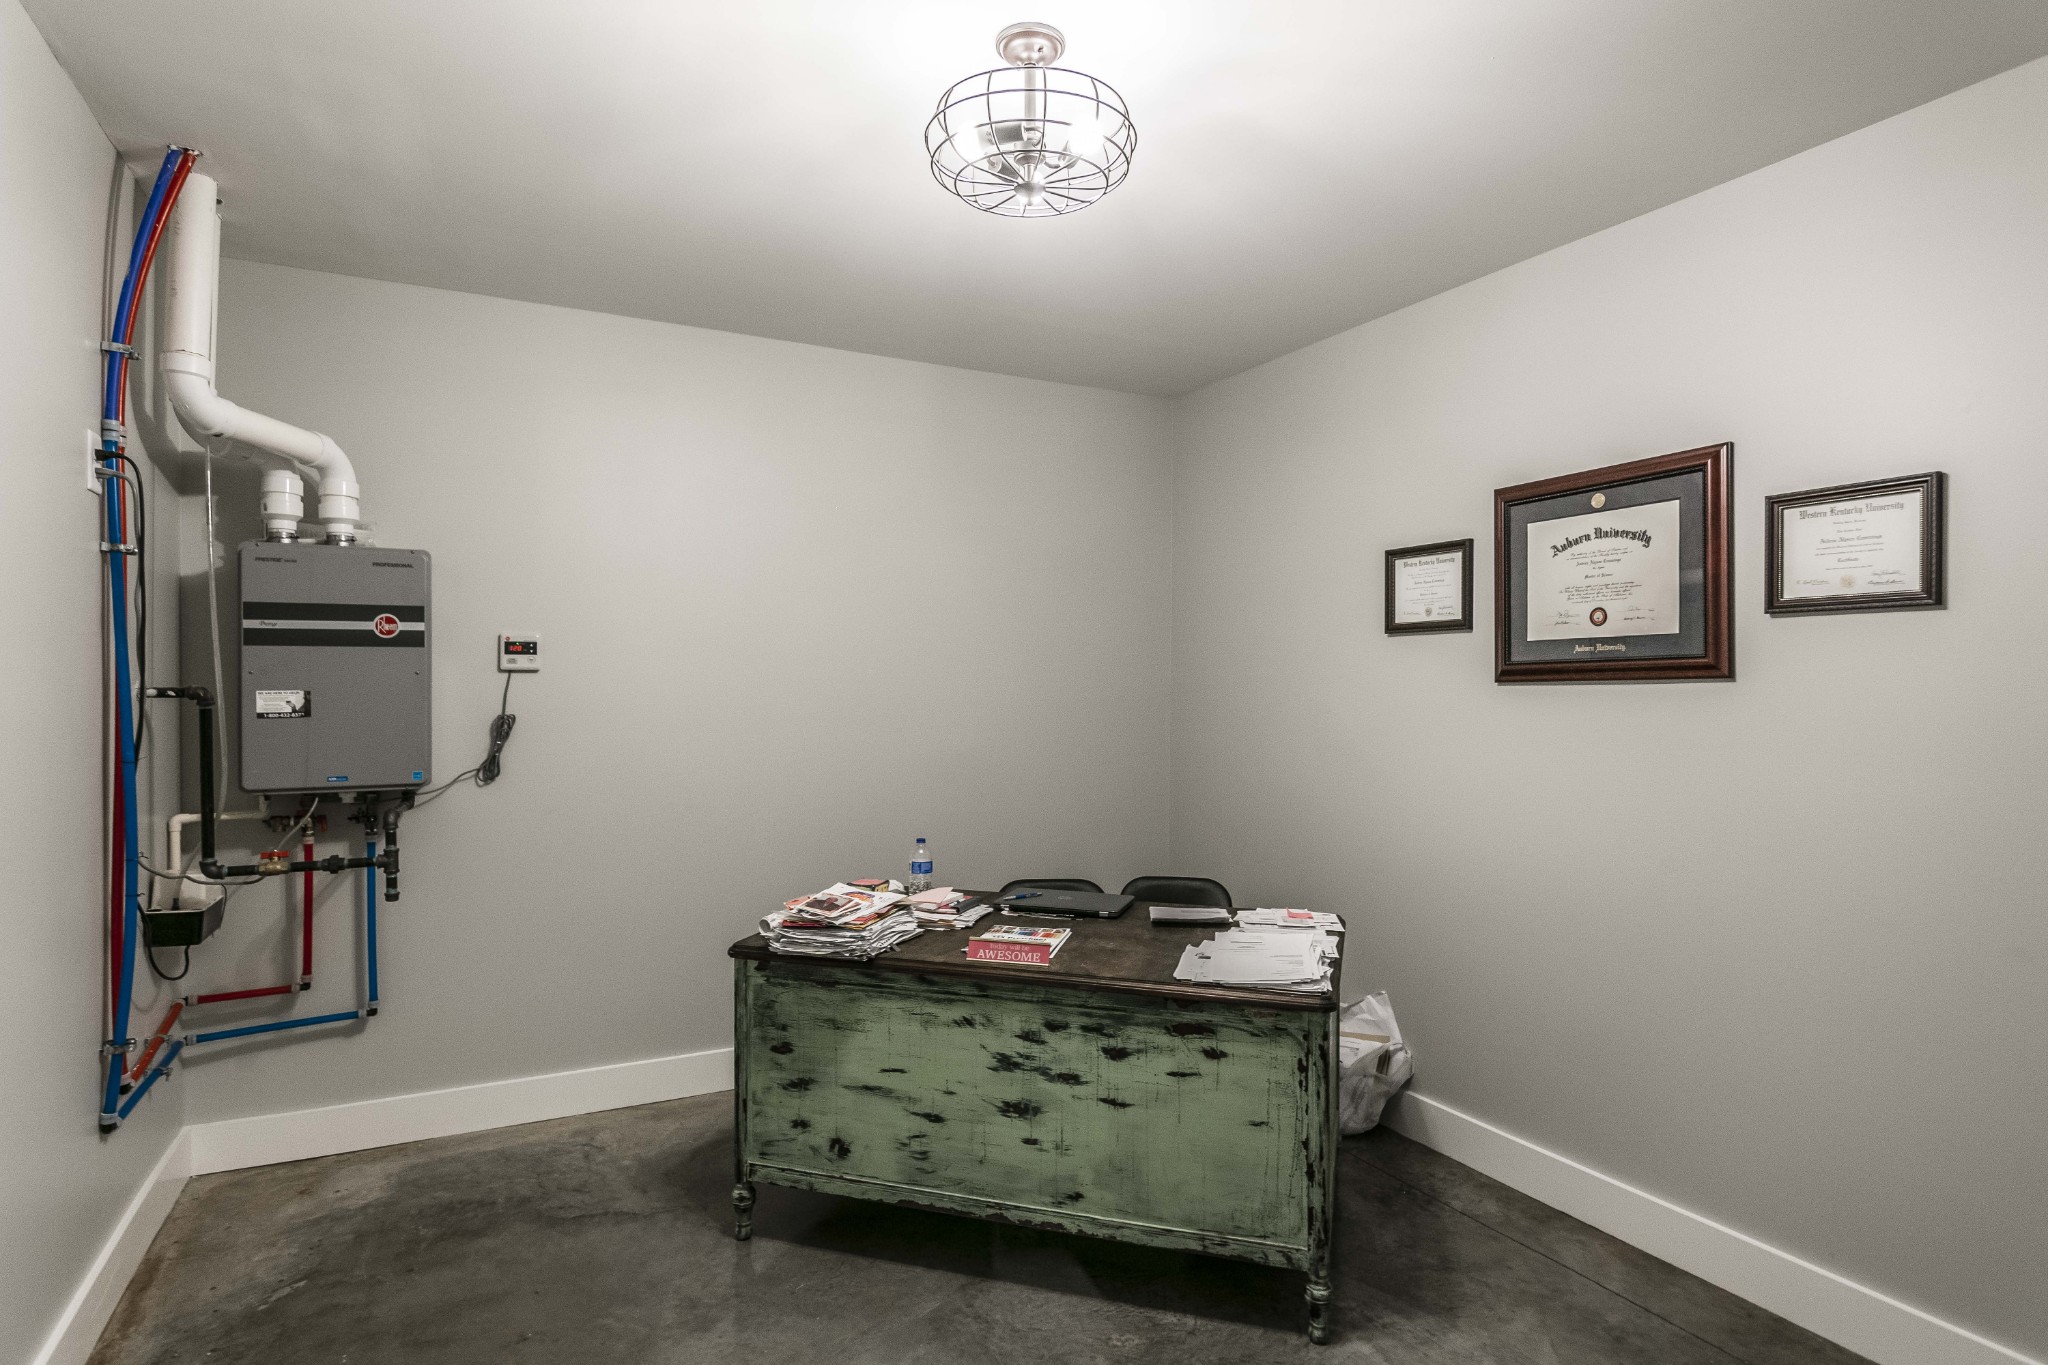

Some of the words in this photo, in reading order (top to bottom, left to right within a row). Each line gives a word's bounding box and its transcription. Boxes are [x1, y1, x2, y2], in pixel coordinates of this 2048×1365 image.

[1799, 509, 1827, 520] Western
[1829, 506, 1863, 517] Kentucky
[1865, 501, 1905, 513] University
[1550, 533, 1592, 558] Auburn
[1593, 526, 1652, 548] University
[372, 561, 414, 569] PROFESSIONAL
[377, 616, 399, 634] Rheem
[1573, 644, 1595, 654] Auburn
[1595, 643, 1626, 653] University
[989, 942, 1007, 951] Today
[977, 949, 1041, 962] AWESOME
